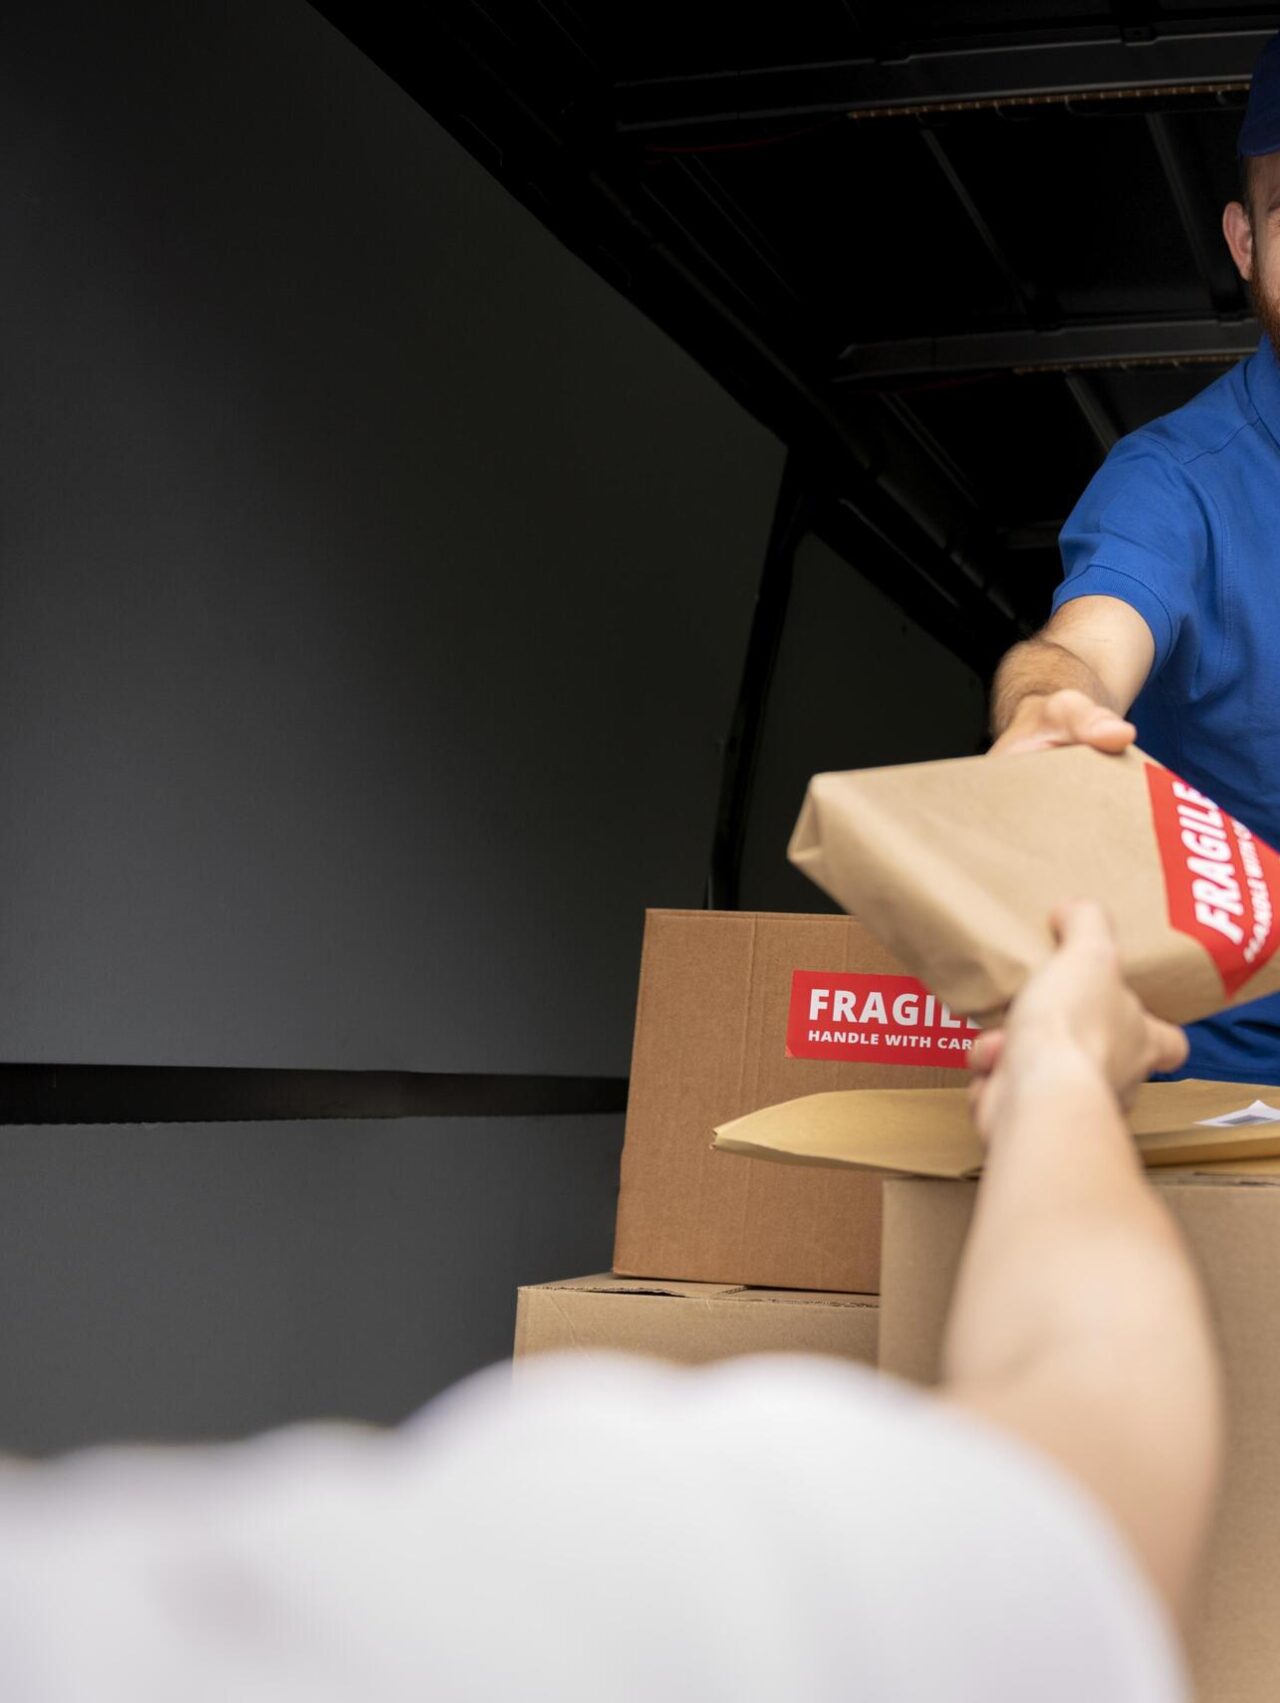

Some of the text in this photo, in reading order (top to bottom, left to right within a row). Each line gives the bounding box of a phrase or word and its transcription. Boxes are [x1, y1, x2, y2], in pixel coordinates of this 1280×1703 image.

[808, 988, 983, 1030] FRAGIL
[807, 1029, 978, 1051] HANDLE WITH CAR
